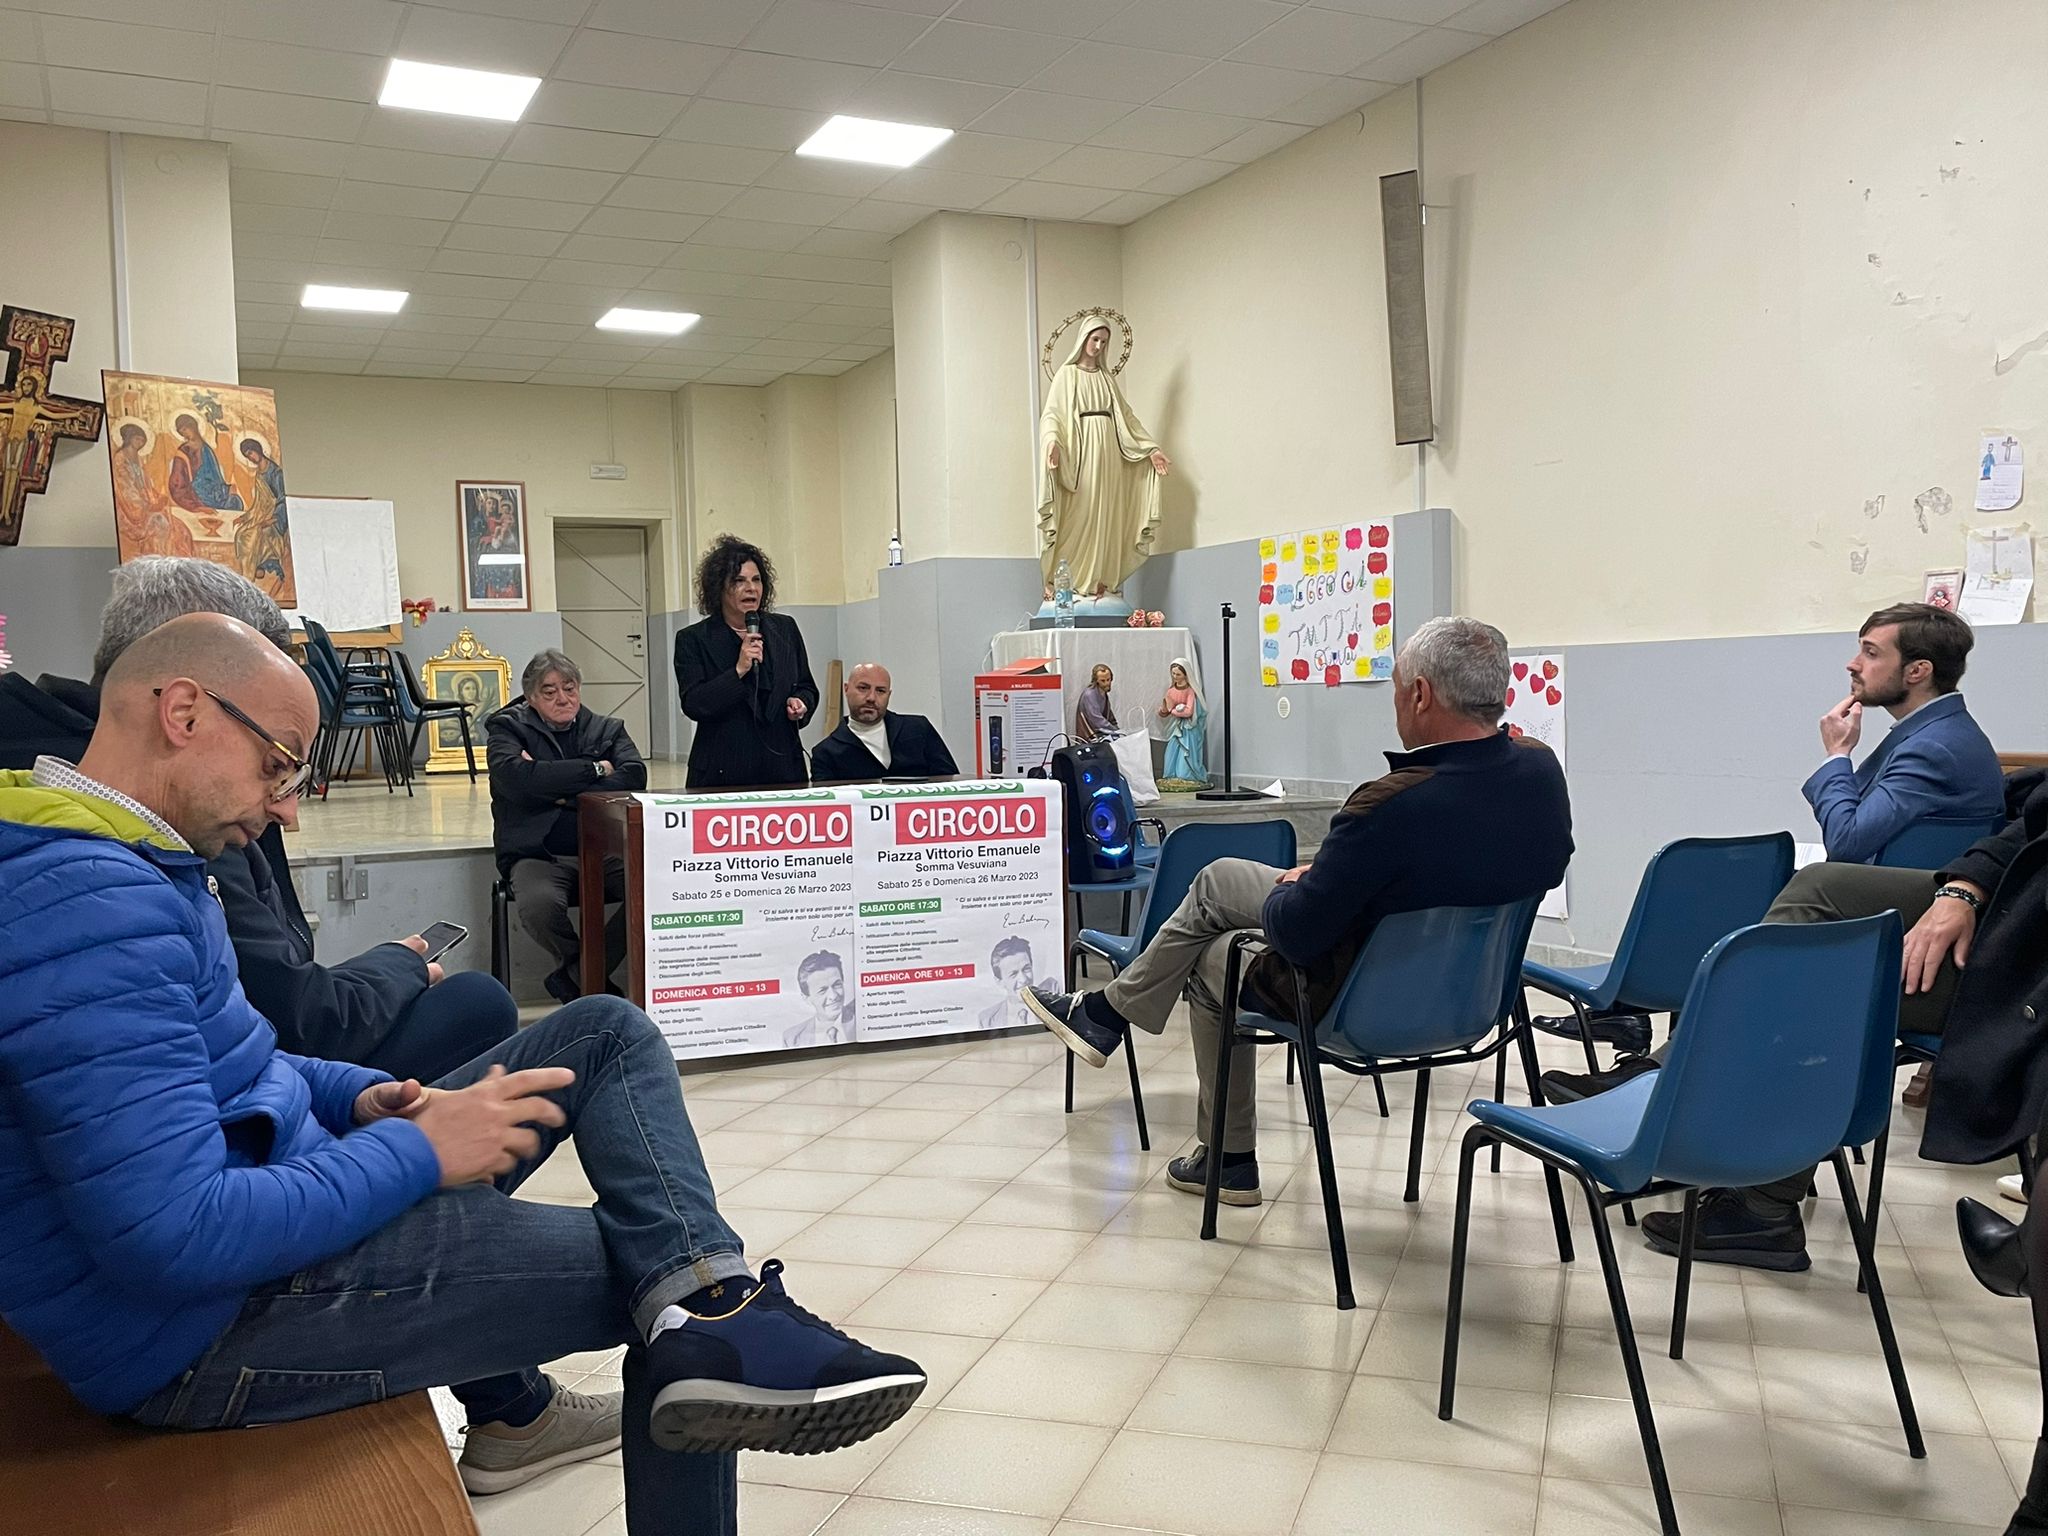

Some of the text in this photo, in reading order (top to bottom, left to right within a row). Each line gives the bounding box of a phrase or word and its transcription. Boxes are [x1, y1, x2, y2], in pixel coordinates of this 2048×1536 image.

[665, 811, 849, 847] DI CIRCOLO
[870, 804, 1036, 838] DI CIRCOLO
[878, 843, 1040, 863] Piazza Vittorio Emanuele
[672, 853, 853, 873] Piazza Vittorio Emanuele
[916, 859, 1007, 873] Somma Vesuviana
[715, 870, 816, 883] Somma Vesuviana
[878, 881, 910, 890] Sabato
[912, 879, 922, 888] 25
[933, 875, 976, 886] Domenica
[978, 875, 989, 883] 26
[991, 874, 1016, 882] Marzo
[1019, 872, 1039, 880] 2023
[672, 891, 707, 901] Sabato
[711, 890, 722, 899] 25
[733, 885, 782, 898] Domenica
[784, 886, 796, 895] 26
[799, 885, 827, 894] Marzo
[830, 883, 851, 892] 2023
[860, 903, 895, 913] SABATO
[897, 902, 915, 910] ORE
[918, 901, 938, 909] 17:30
[653, 913, 740, 926] SABATO ORE 17:30
[863, 972, 910, 984] DOMENICA
[914, 970, 932, 979] ORE
[953, 968, 963, 976] 13
[655, 987, 707, 1000] DOMENICA
[712, 986, 732, 995] ORE
[735, 985, 745, 994] 10
[756, 984, 766, 992] 13
